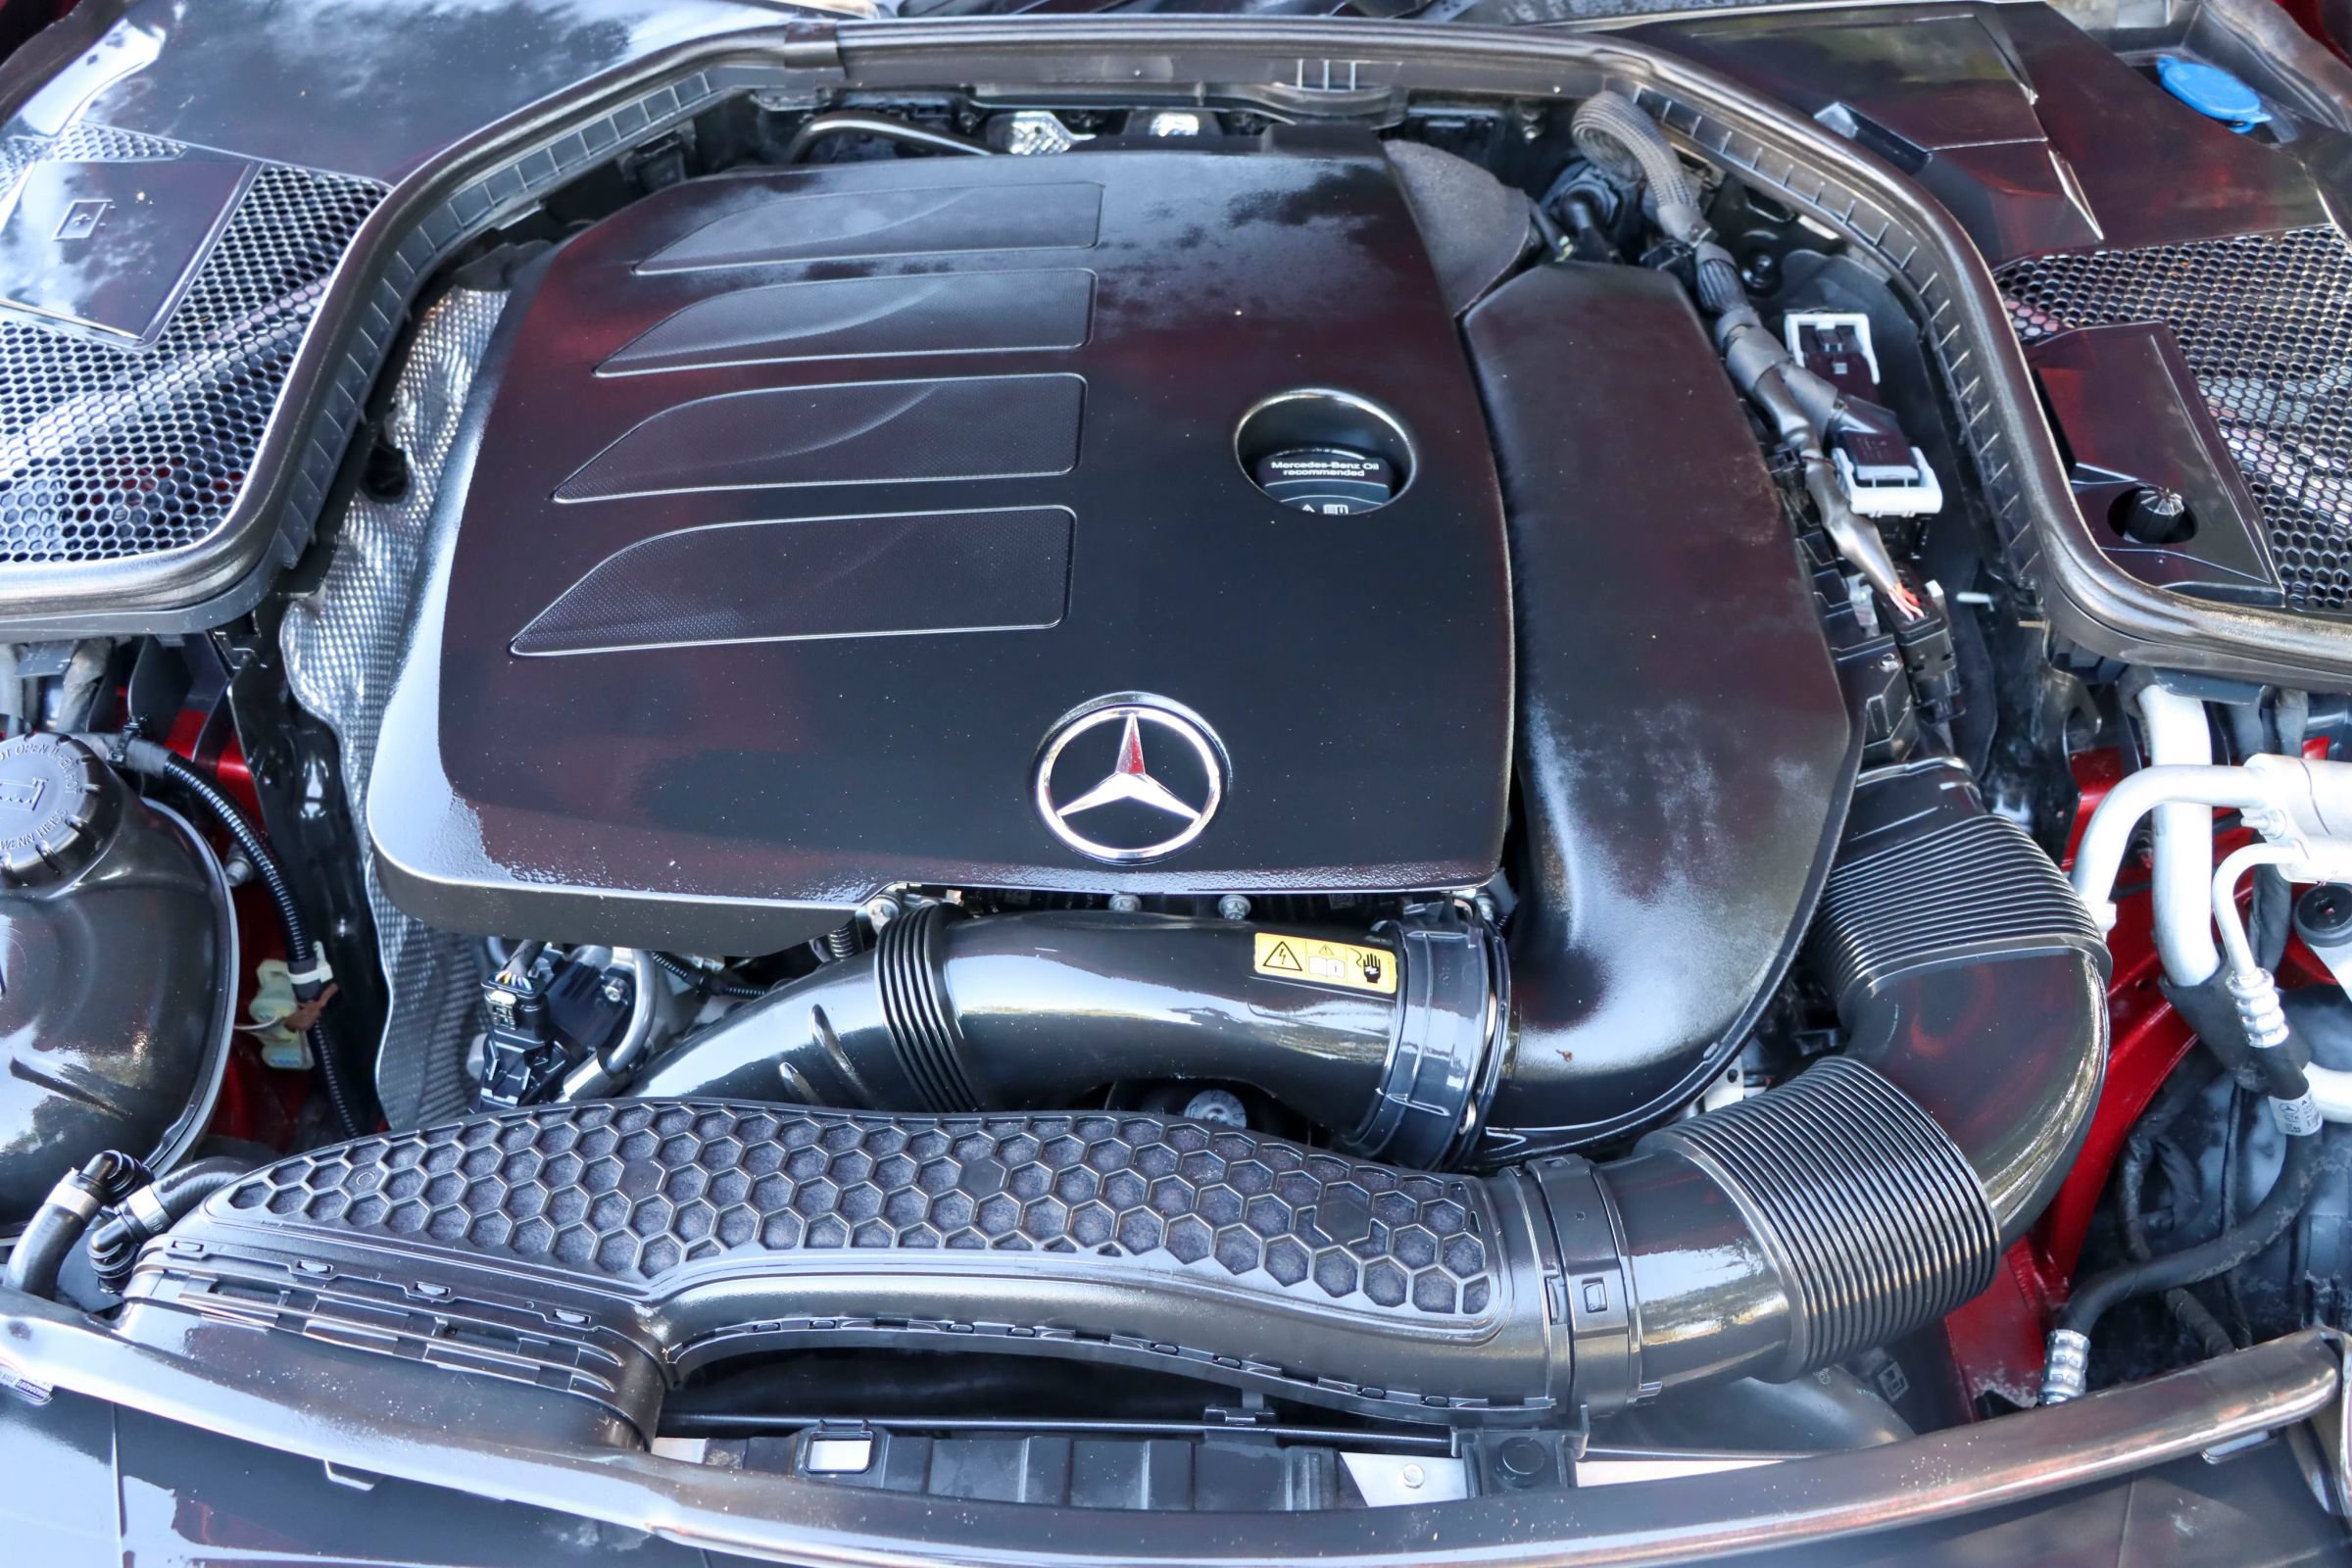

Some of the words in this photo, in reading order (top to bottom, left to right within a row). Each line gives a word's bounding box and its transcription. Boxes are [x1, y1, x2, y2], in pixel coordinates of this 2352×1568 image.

[1271, 461, 1360, 469] Mercedes-Benz
[1283, 468, 1365, 477] recommended
[15, 744, 49, 756] OPEN
